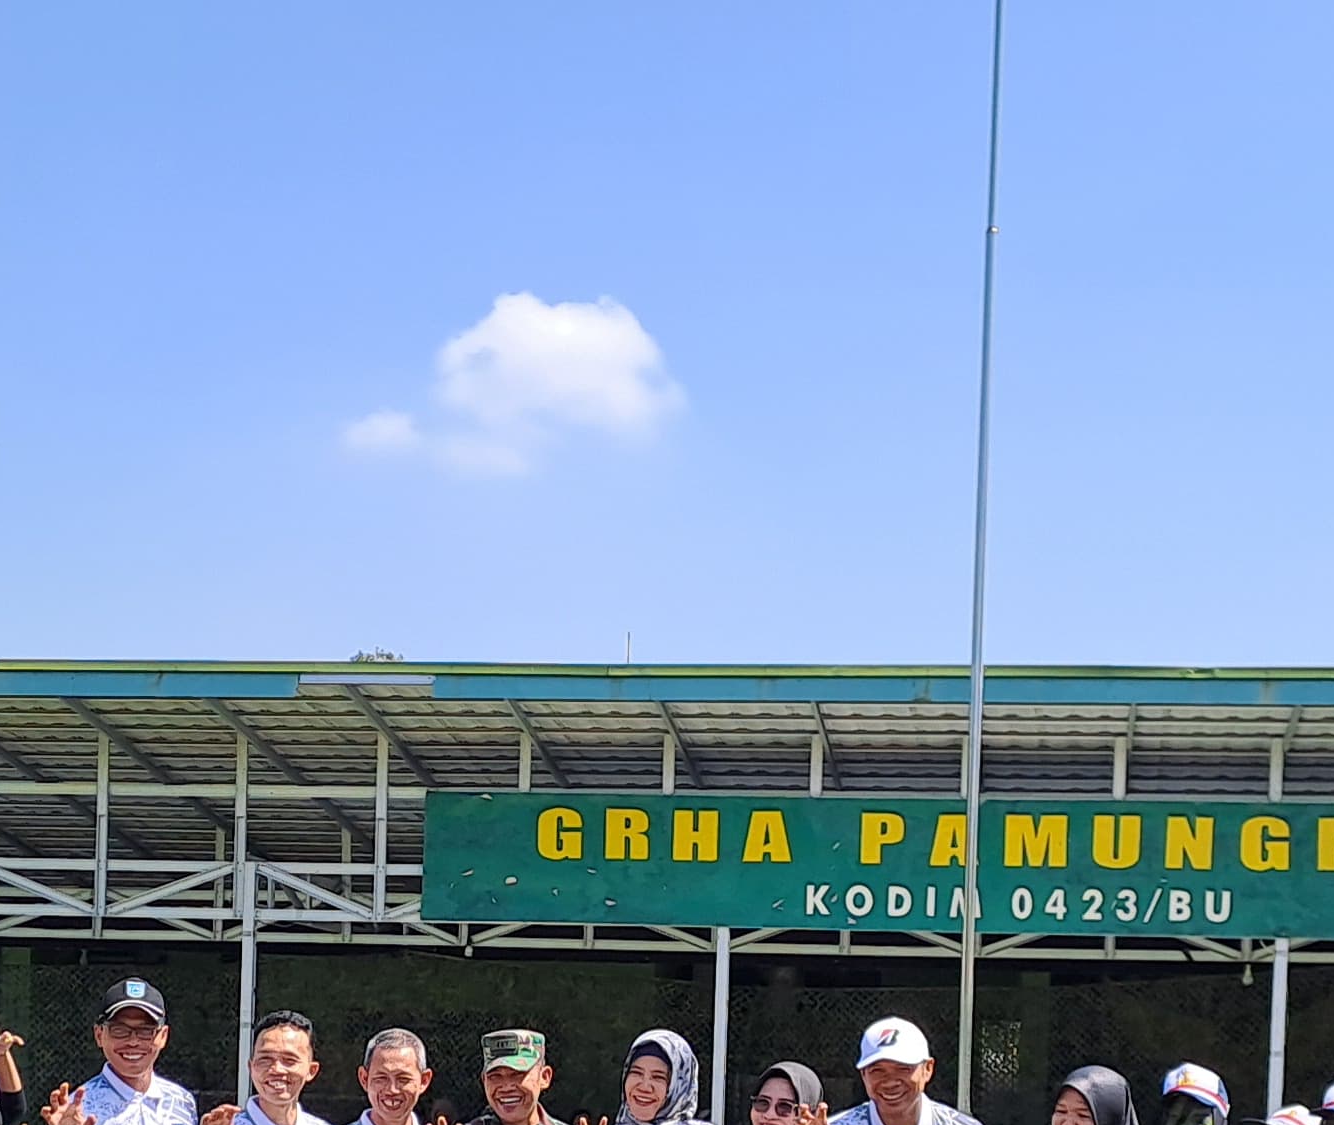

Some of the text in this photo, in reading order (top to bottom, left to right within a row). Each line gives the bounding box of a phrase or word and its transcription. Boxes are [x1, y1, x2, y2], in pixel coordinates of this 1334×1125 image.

[537, 807, 792, 863] GRHA
[805, 884, 1231, 923] KODIM 0423/BU
